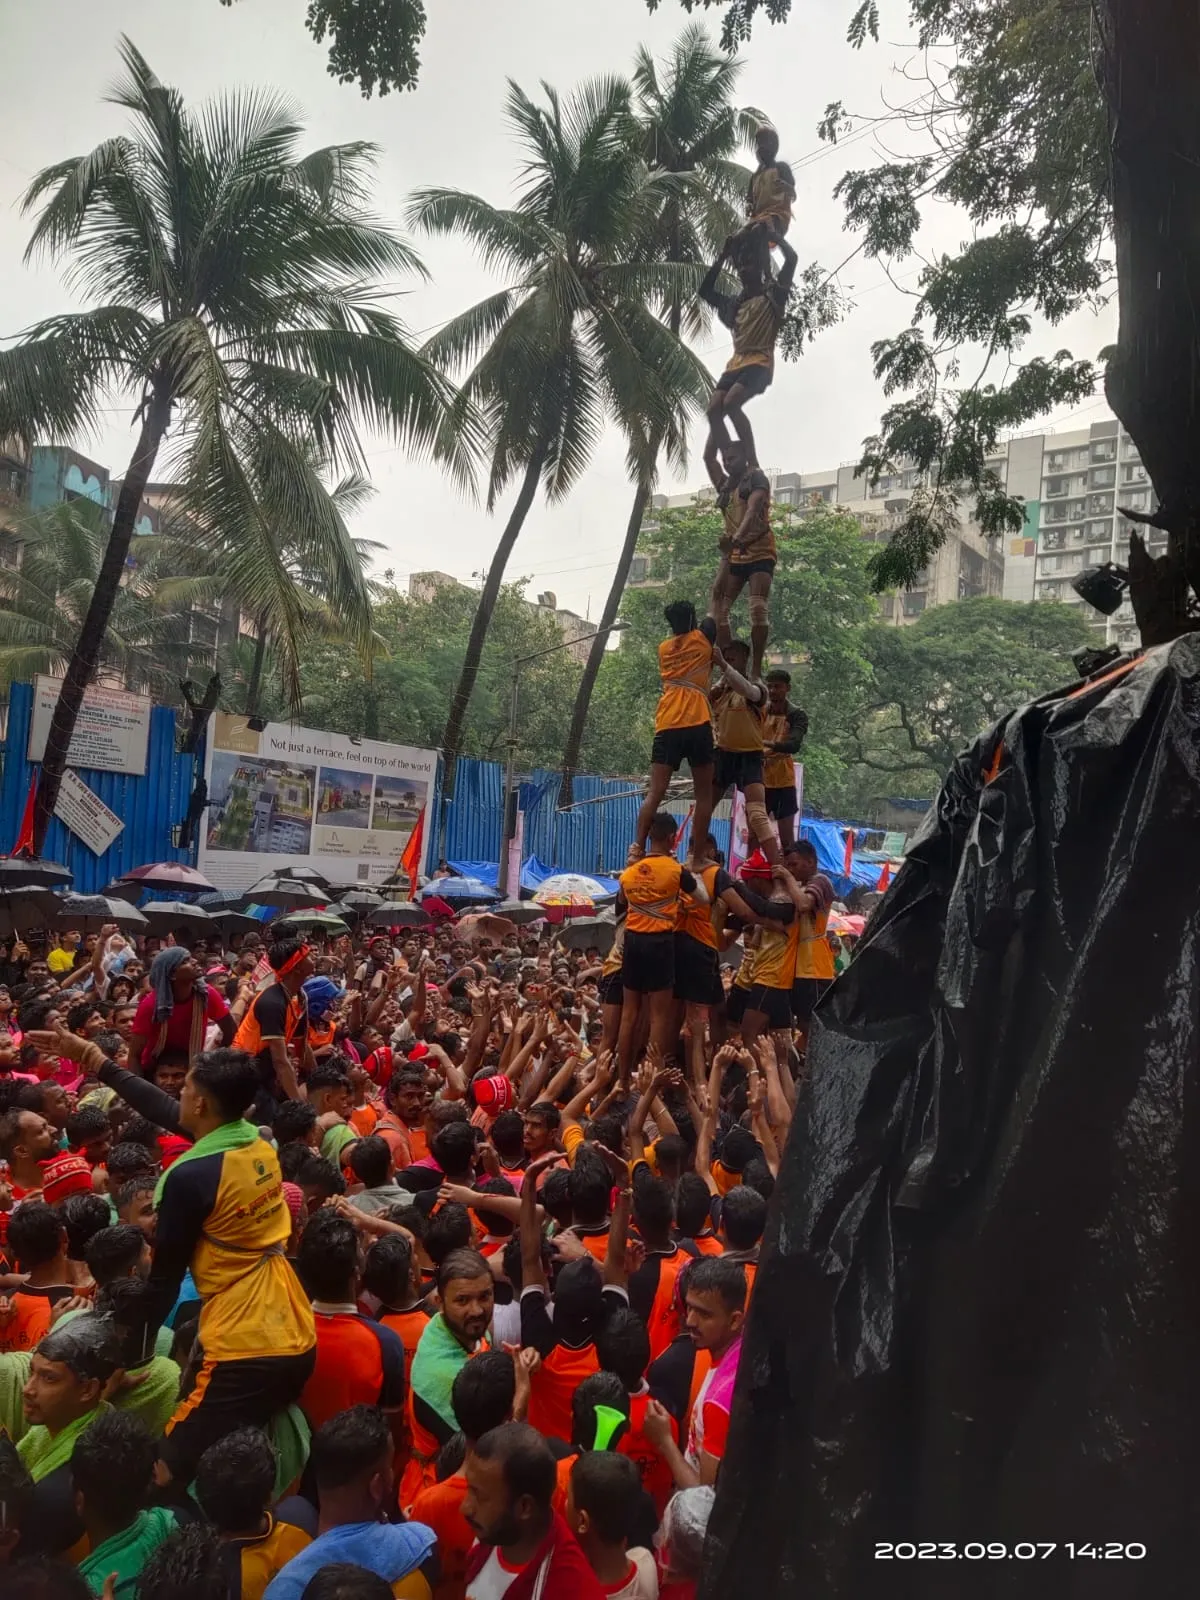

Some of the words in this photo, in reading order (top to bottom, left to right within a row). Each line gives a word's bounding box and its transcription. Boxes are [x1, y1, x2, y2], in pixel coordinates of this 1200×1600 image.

[270, 738, 286, 750] Not
[288, 743, 304, 753] just
[346, 752, 360, 762] feel
[362, 755, 373, 763] on
[374, 757, 387, 767] top
[388, 758, 398, 768] of
[398, 759, 410, 769] the
[411, 762, 431, 773] world
